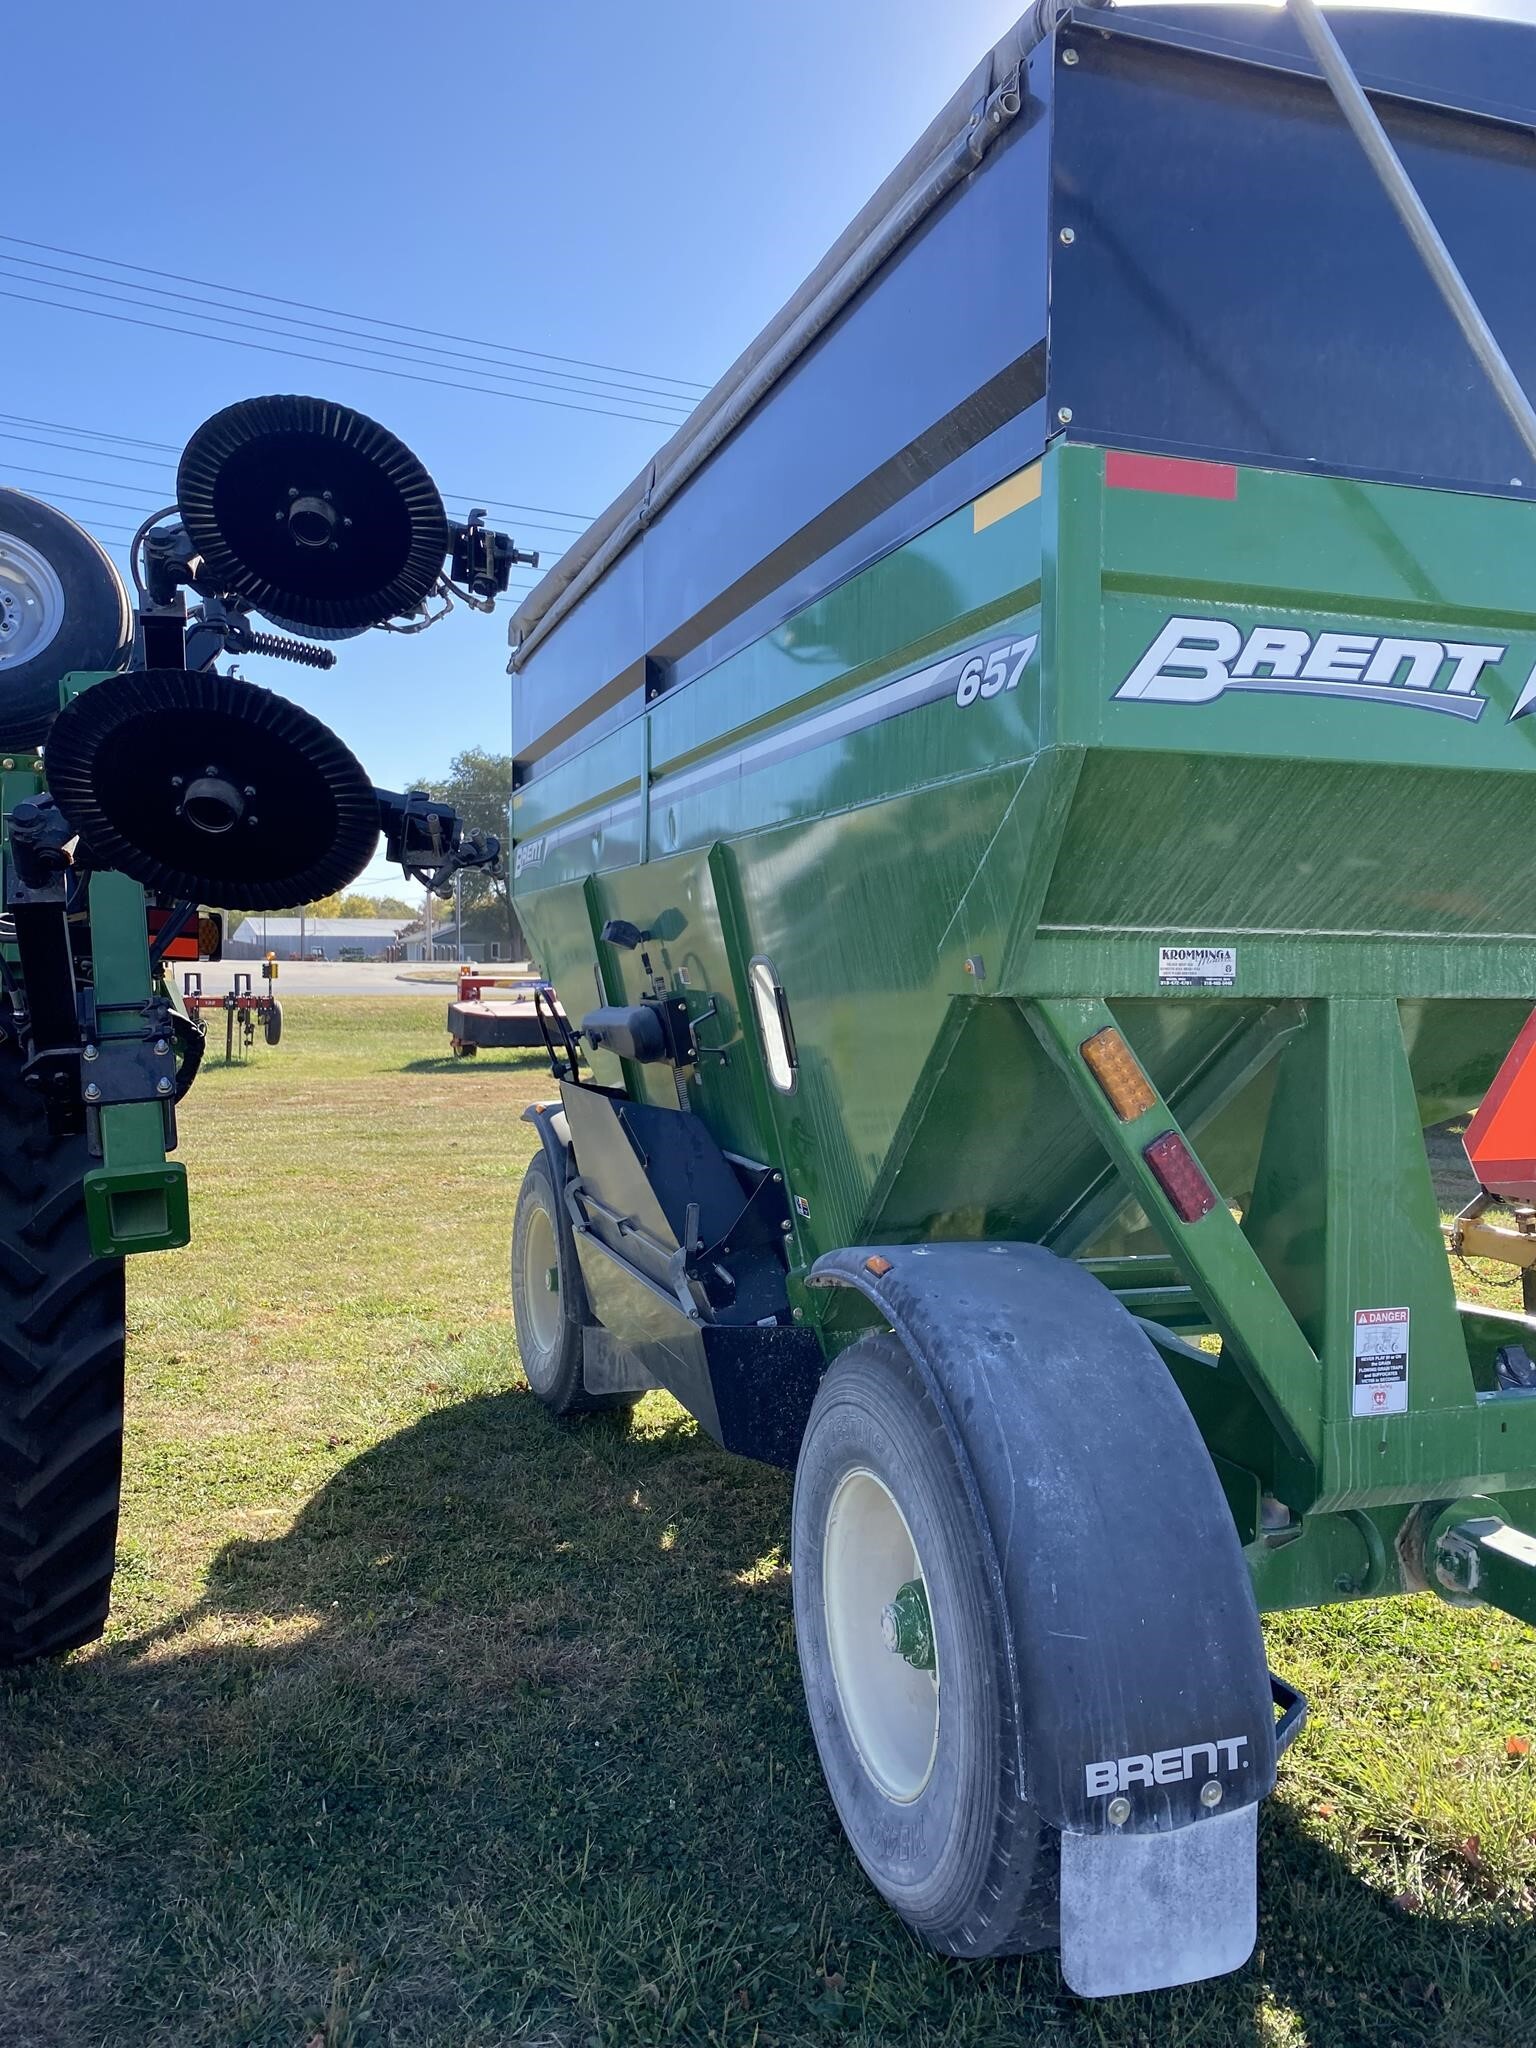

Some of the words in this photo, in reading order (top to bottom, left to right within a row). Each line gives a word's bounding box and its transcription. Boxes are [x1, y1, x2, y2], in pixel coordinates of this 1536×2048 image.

[956, 632, 1038, 708] 657
[1112, 616, 1506, 702] BRENT
[1162, 949, 1232, 960] KROMMINGA
[1369, 1311, 1407, 1323] DANGER
[1085, 1736, 1248, 1798] BRENT
